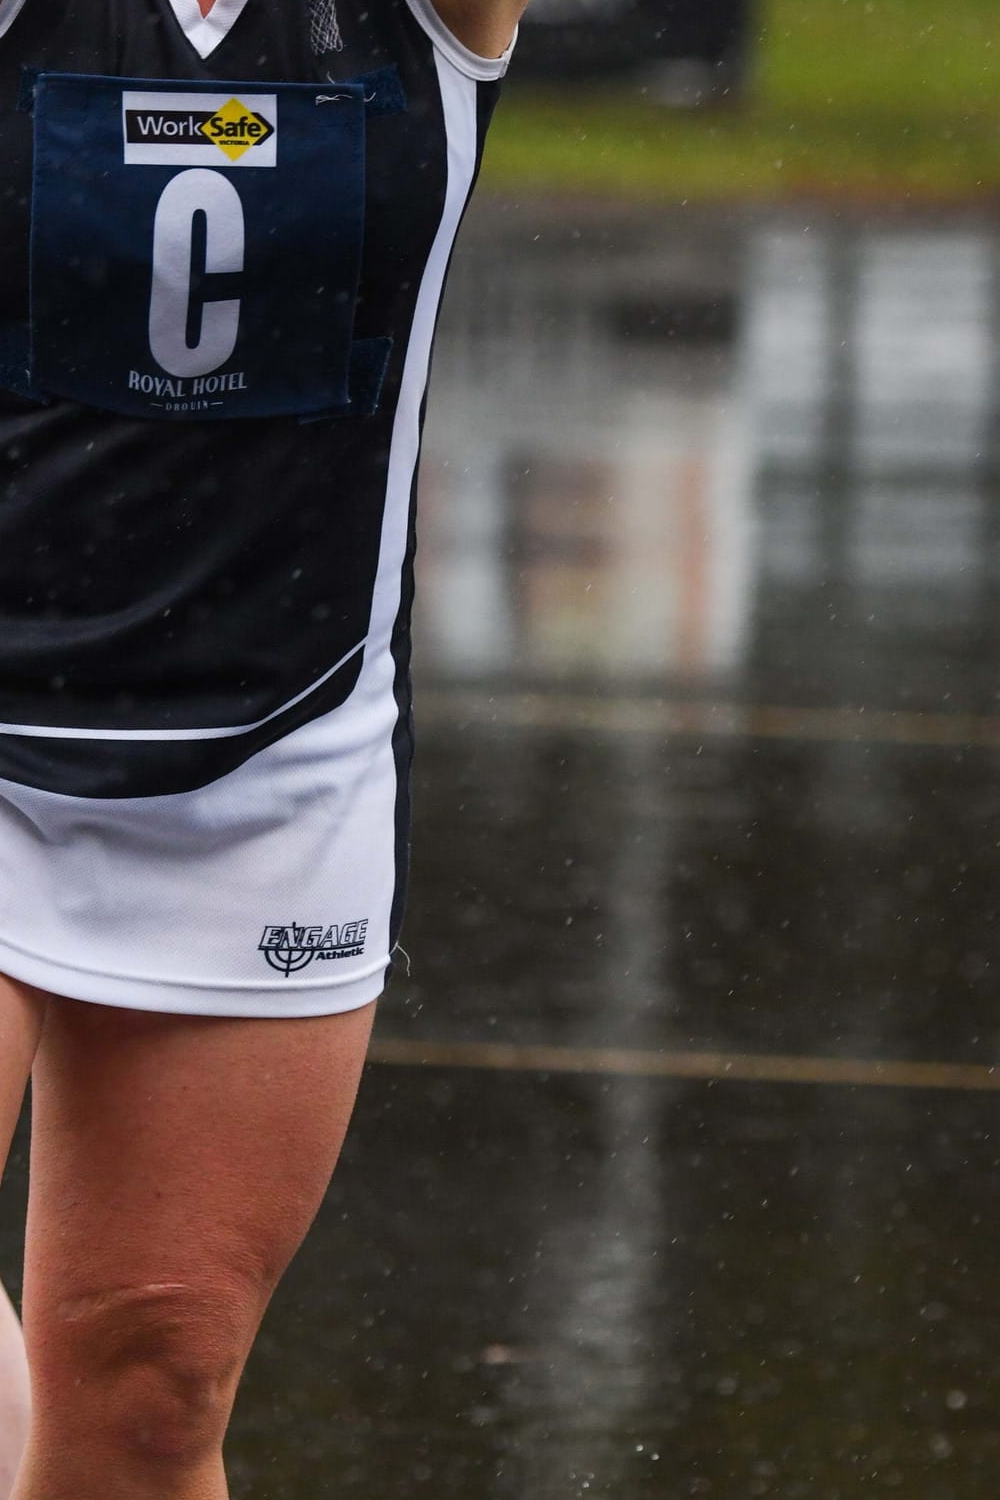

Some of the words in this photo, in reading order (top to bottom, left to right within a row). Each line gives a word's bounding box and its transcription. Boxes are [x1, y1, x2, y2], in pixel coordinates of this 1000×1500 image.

[148, 168, 245, 378] C
[128, 370, 186, 398] ROYAL
[192, 372, 248, 395] HOTEL
[258, 918, 369, 950] ENGAGE
[315, 947, 365, 961] Athletic
